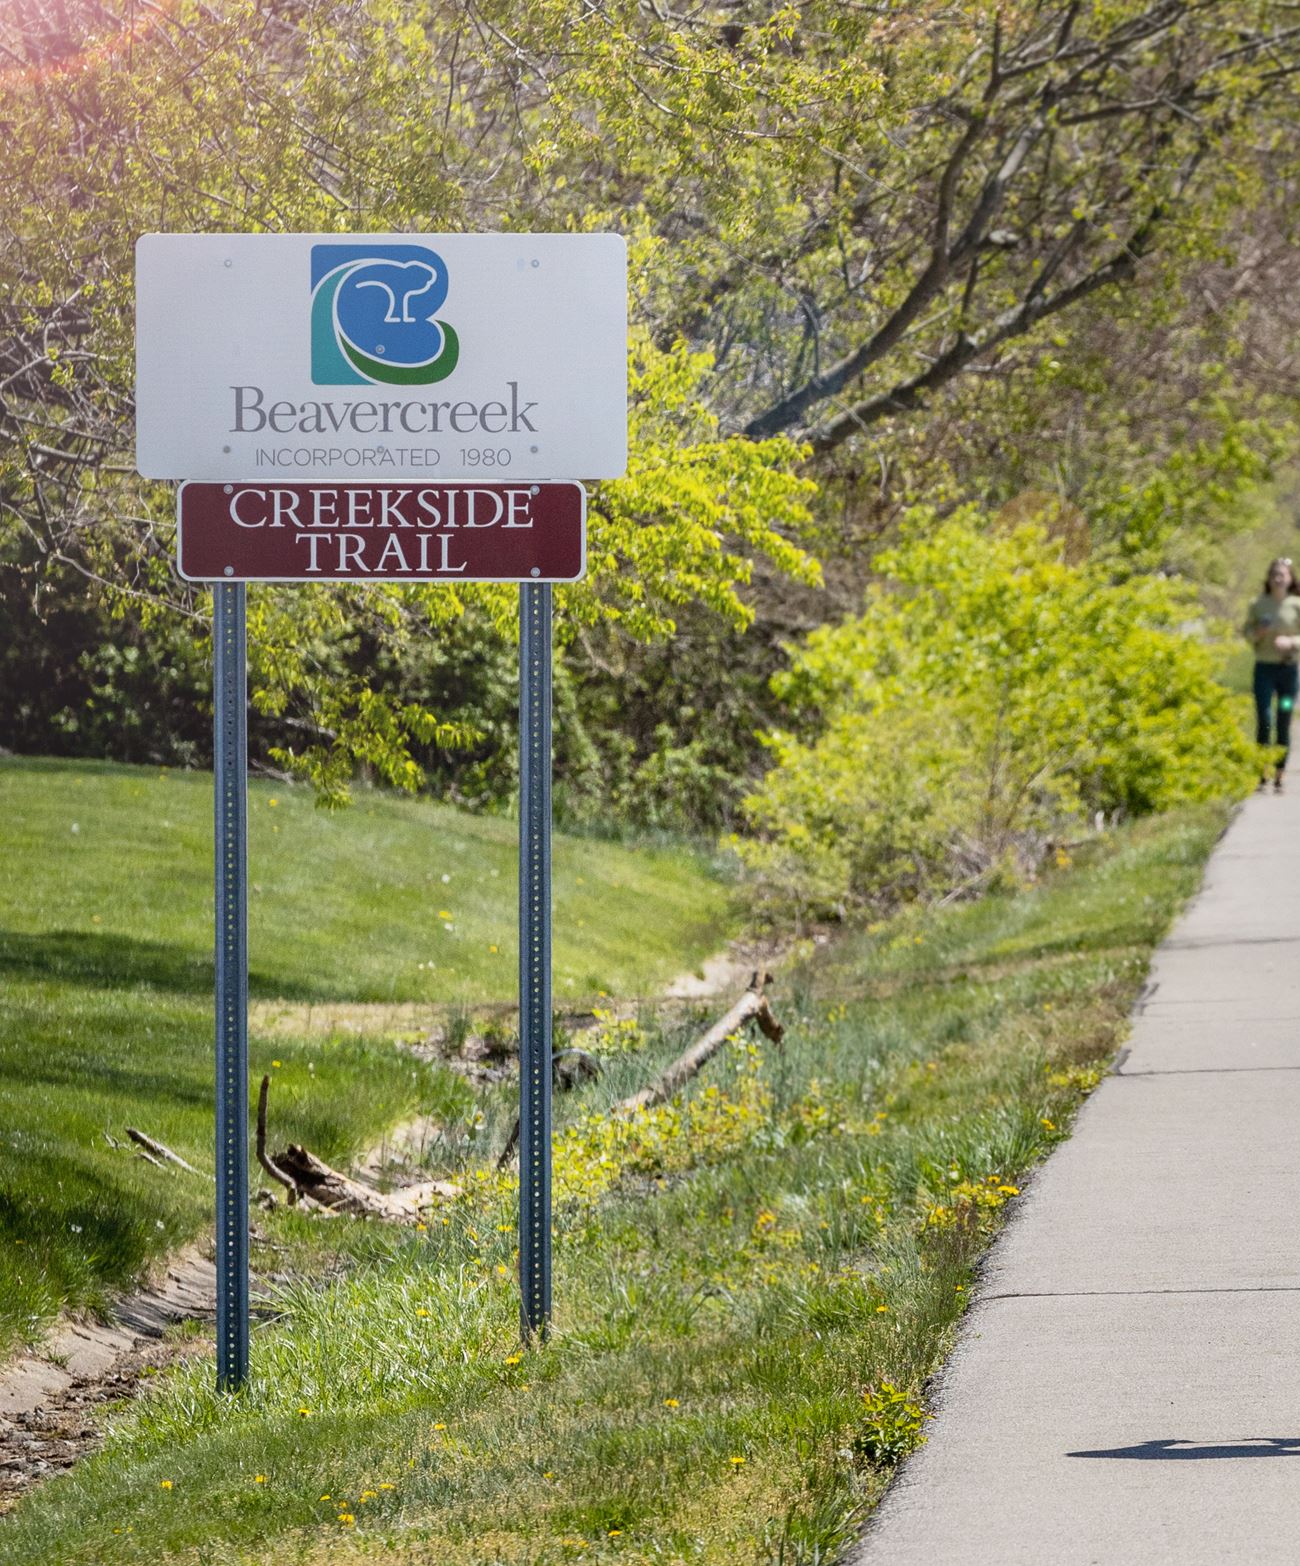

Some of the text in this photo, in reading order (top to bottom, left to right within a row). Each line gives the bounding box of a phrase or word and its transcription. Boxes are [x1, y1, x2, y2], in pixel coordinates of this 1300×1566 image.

[229, 381, 538, 433] Beavercreek
[256, 448, 512, 467] INCORPORATED 1980
[229, 488, 534, 529] CREEKSIDE
[295, 533, 468, 573] TRAIL
